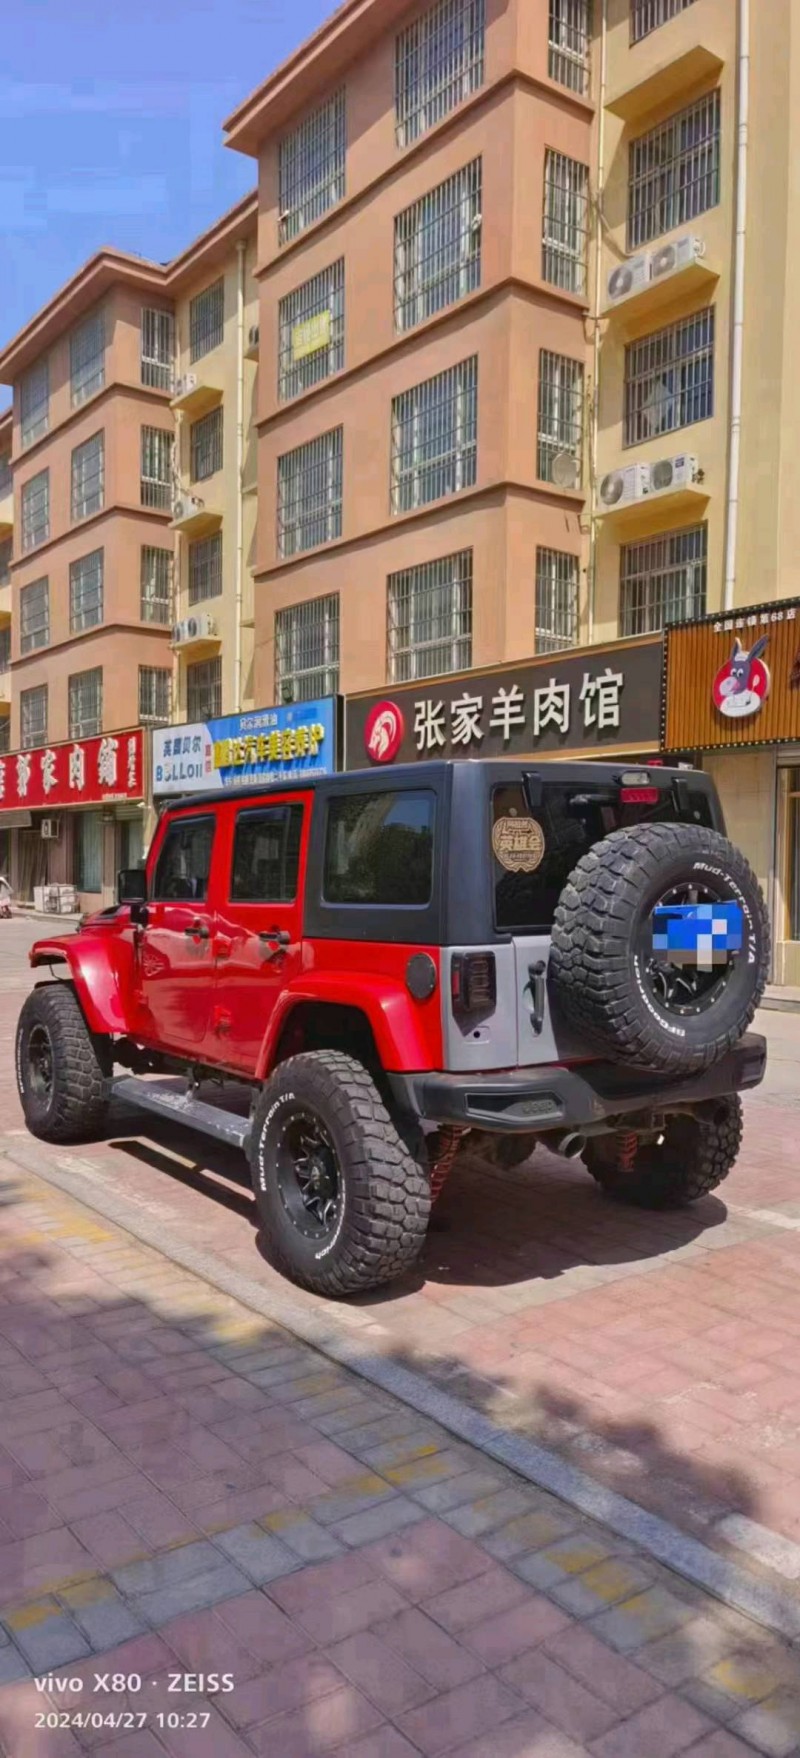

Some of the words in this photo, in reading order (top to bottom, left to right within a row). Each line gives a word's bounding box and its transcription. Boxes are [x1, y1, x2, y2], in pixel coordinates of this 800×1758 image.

[413, 668, 624, 751] 张家羊肉馆
